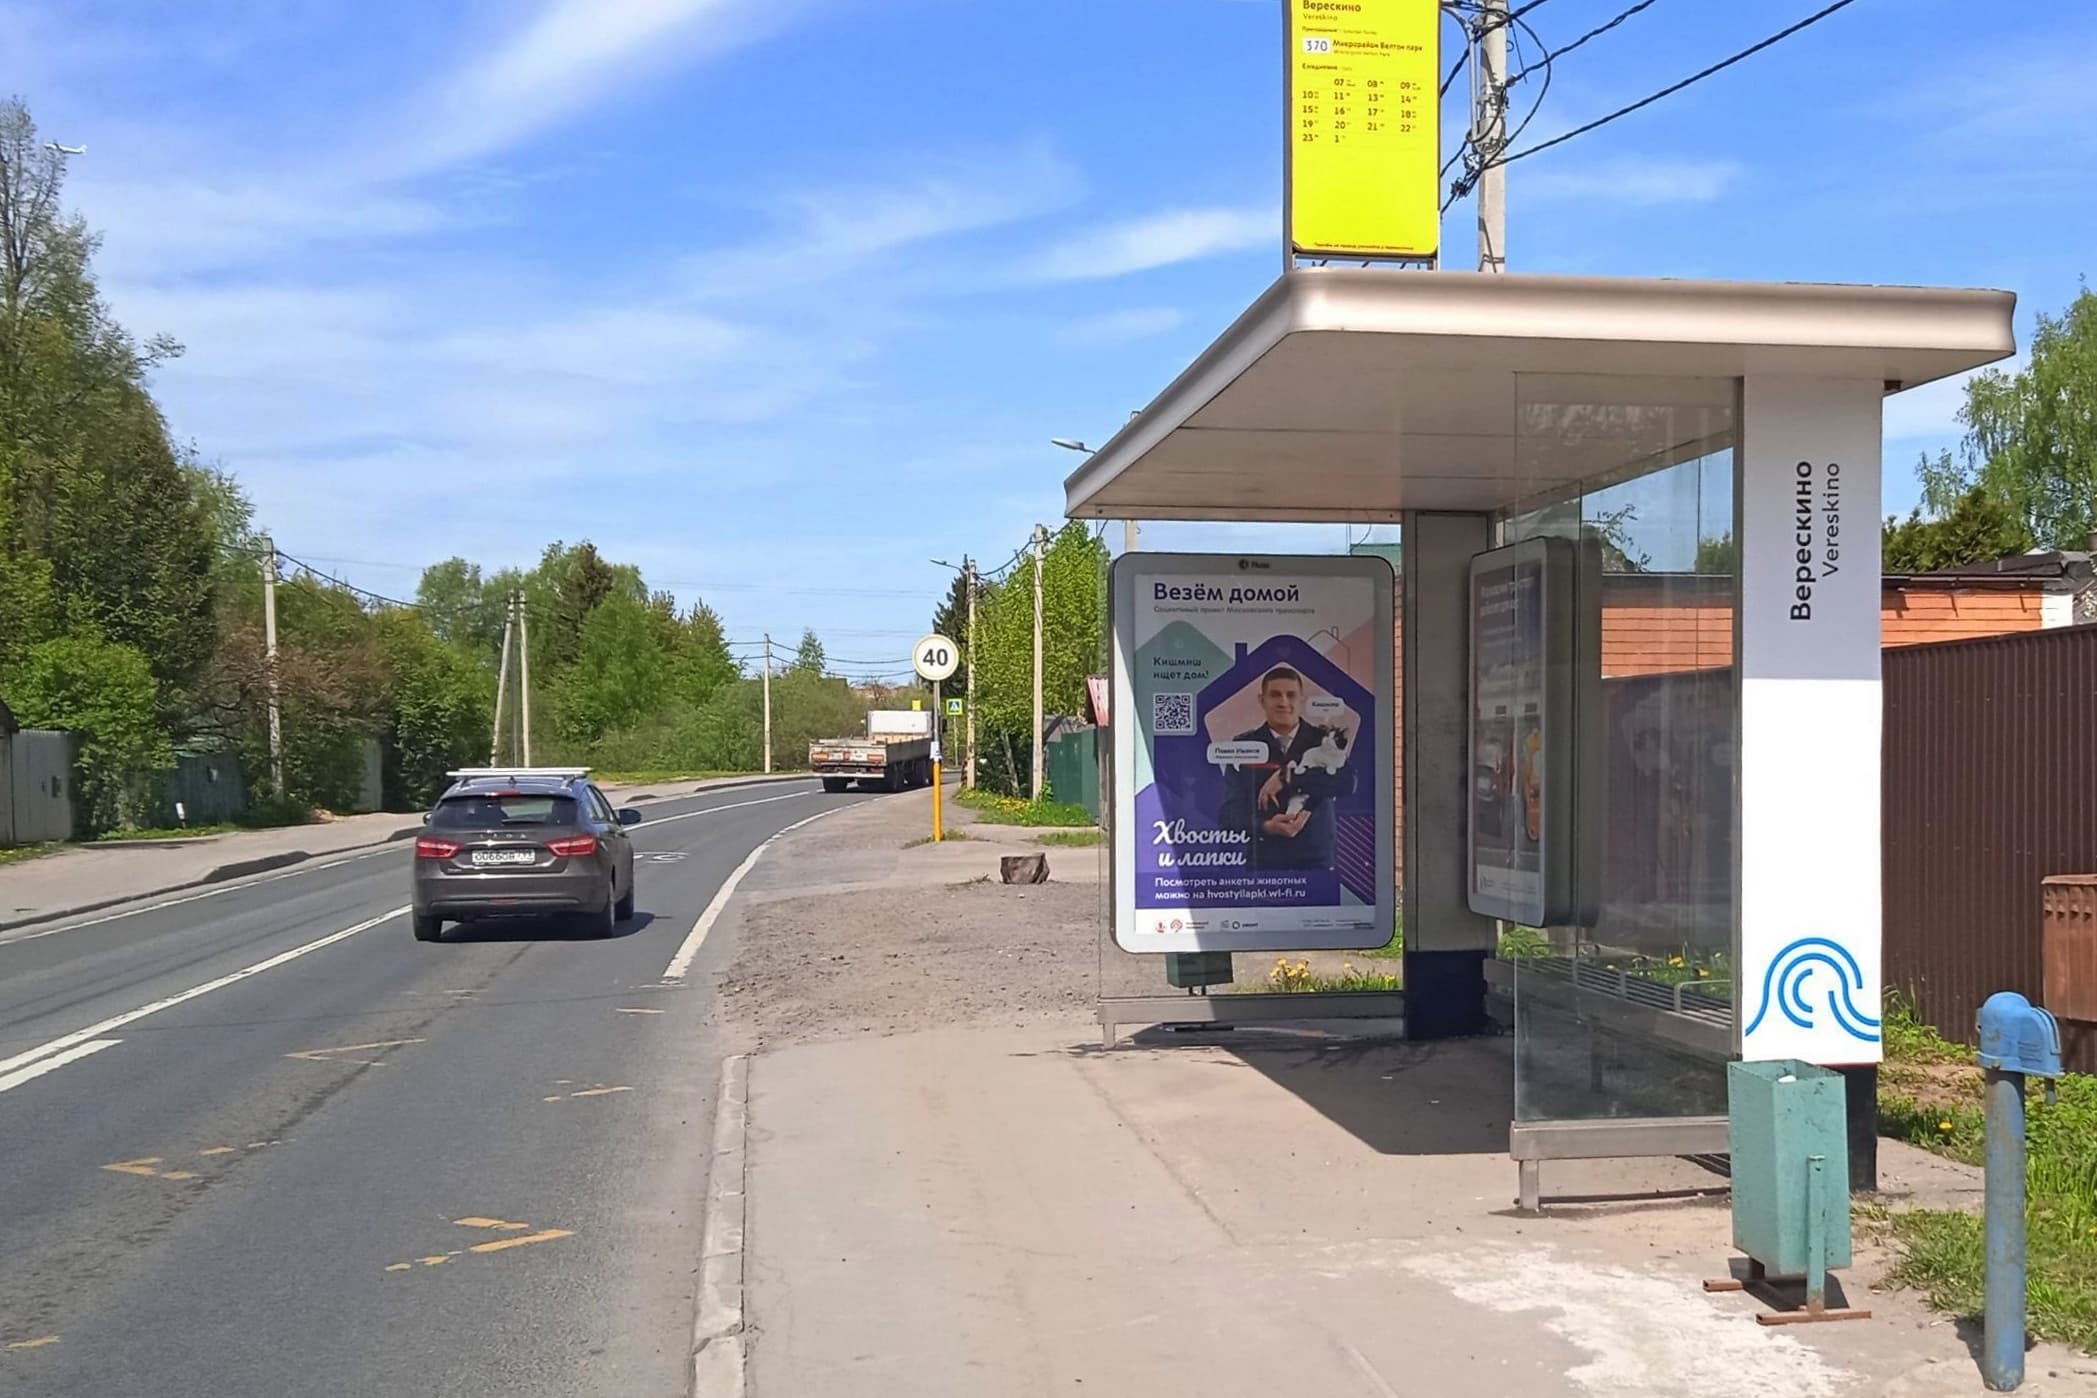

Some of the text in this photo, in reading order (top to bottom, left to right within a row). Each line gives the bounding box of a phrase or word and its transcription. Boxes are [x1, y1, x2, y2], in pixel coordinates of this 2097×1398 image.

[1303, 0, 1361, 12] Верескино
[1306, 40, 1328, 51] 370
[1334, 78, 1344, 86] 07
[1303, 91, 1411, 103] 10 11 13 14
[1303, 105, 1313, 113] 15
[1335, 107, 1345, 115] 16
[1368, 108, 1378, 116] 17
[1303, 120, 1411, 132] 19 20 21 22
[1302, 134, 1313, 142] 23
[1822, 463, 1840, 577] Vereskino
[1790, 461, 1816, 620] Верескино
[1154, 582, 1299, 604] Везём домой
[923, 648, 948, 666] 40
[1153, 656, 1201, 667] Кишмиш
[1153, 669, 1209, 681] ищет дом!
[1153, 819, 1250, 845] Хвосты
[1158, 850, 1247, 868] и лапки
[1155, 877, 1307, 889] Посмотреть анкеты животных
[1155, 891, 1190, 900] можно
